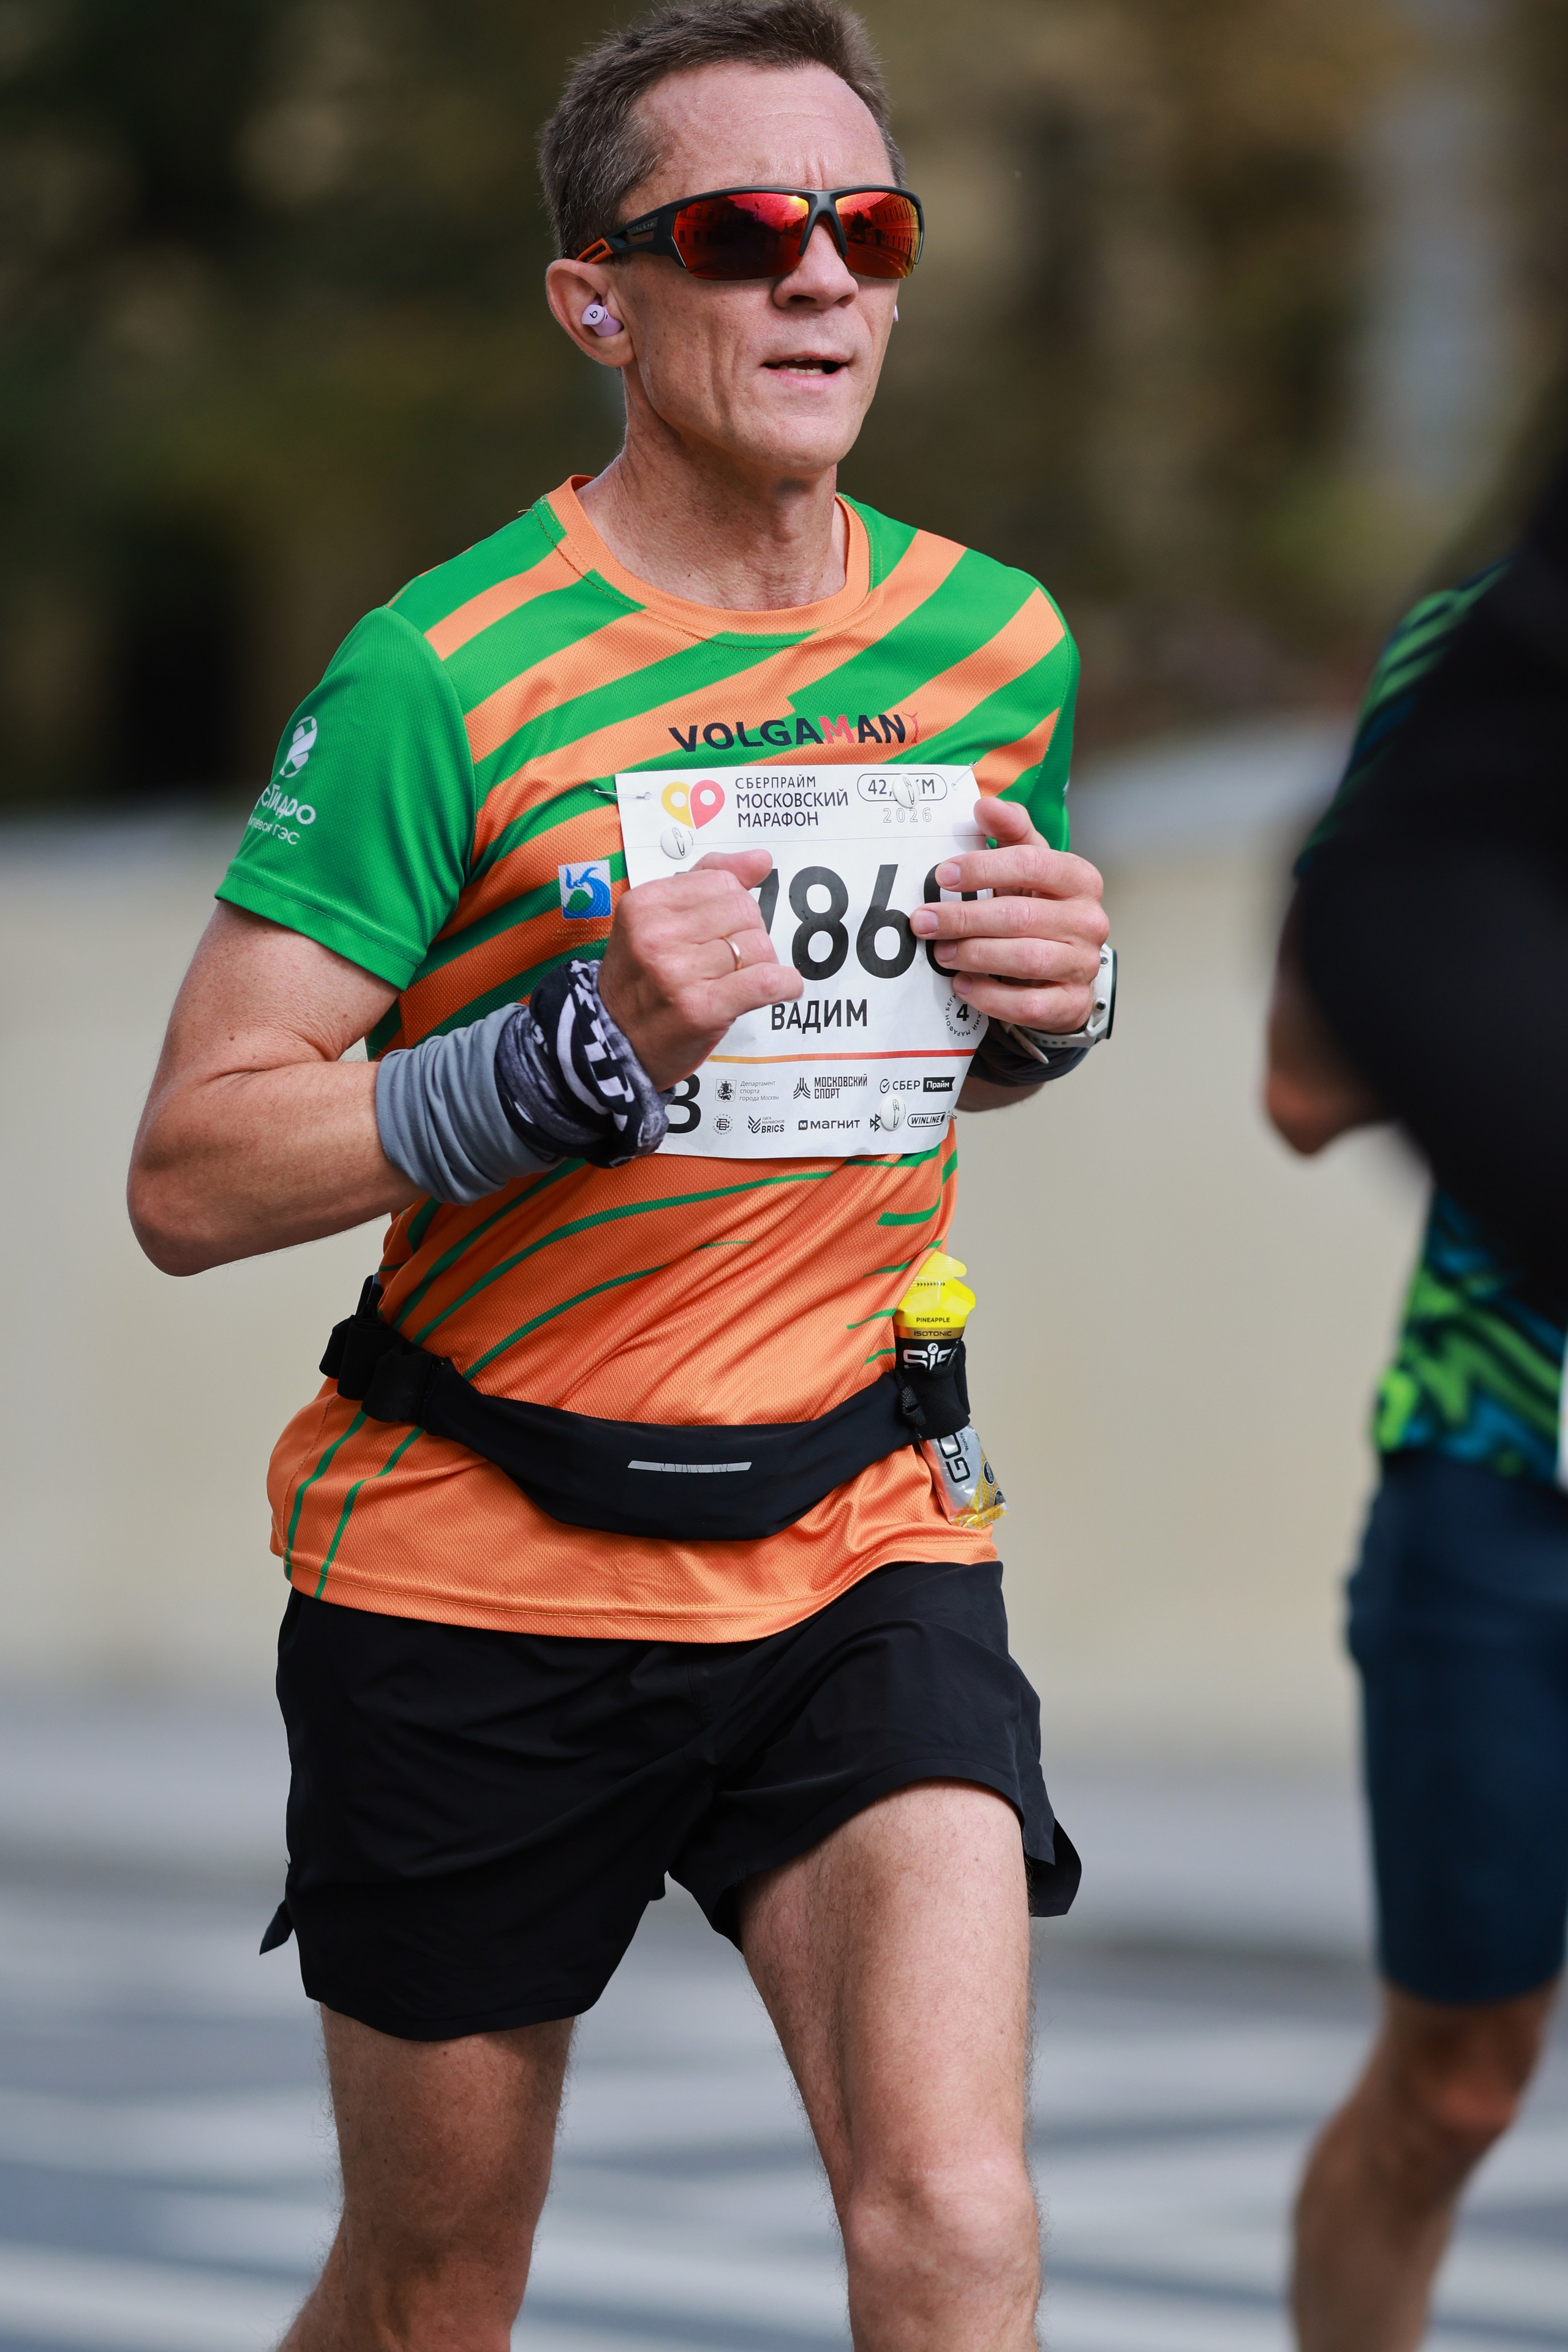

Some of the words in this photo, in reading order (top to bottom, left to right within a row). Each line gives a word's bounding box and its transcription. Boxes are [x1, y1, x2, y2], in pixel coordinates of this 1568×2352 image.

[668, 714, 907, 753] VOLGAMAN
[735, 774, 816, 789] СБЕРПРАЙМ
[868, 779, 893, 797] 42,
[736, 788, 849, 809] МОСКОВСКИЙ
[737, 812, 819, 827] МАРАФОН
[883, 807, 932, 823] 2026
[272, 824, 300, 845] ГЭС
[772, 999, 867, 1034] ВАДИМ
[956, 1003, 969, 1022] 4
[814, 1073, 867, 1087] МОСКОВСКИЙ
[892, 1080, 921, 1090] СБЕР
[926, 1080, 950, 1090] Прайм
[814, 1088, 840, 1099] СПОРТ
[911, 1115, 941, 1125] WINLINE
[761, 1124, 785, 1134] BRICS
